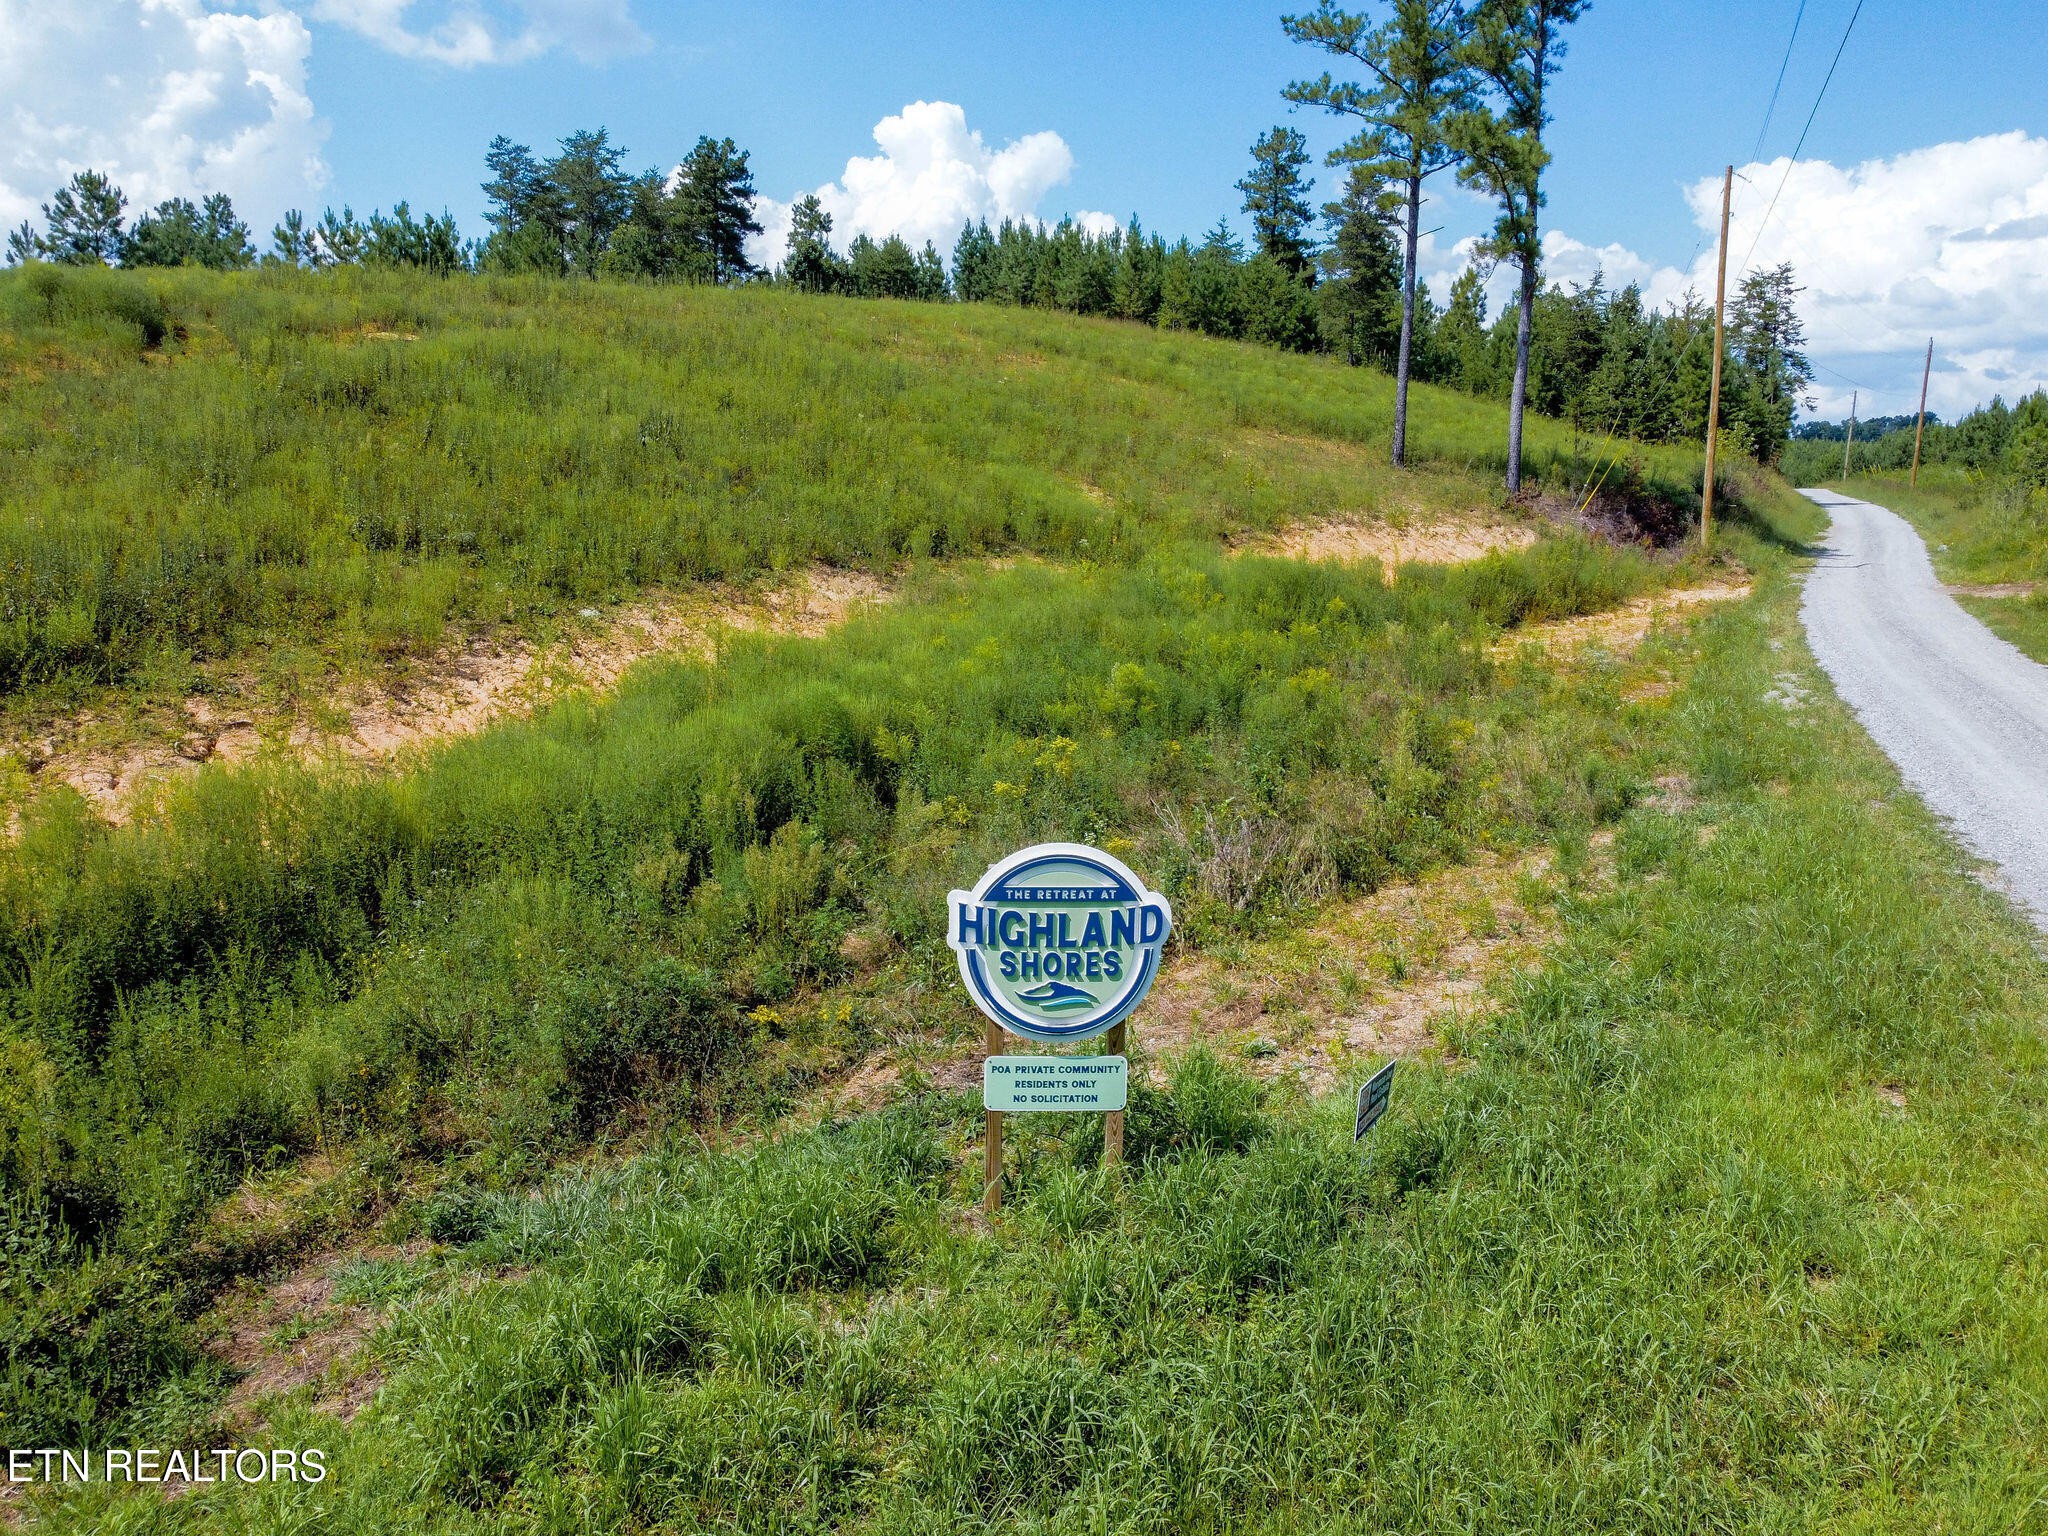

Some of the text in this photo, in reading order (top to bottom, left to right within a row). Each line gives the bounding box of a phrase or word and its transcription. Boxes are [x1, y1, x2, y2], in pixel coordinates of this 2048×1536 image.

[1006, 890, 1117, 900] THE RETREAT AT
[958, 903, 1163, 948] HIGHLAND
[1000, 951, 1120, 977] SHORES
[991, 1066, 1121, 1074] POA PRIVATE COMMUNITY
[1013, 1095, 1098, 1103] NO SOLICITATION
